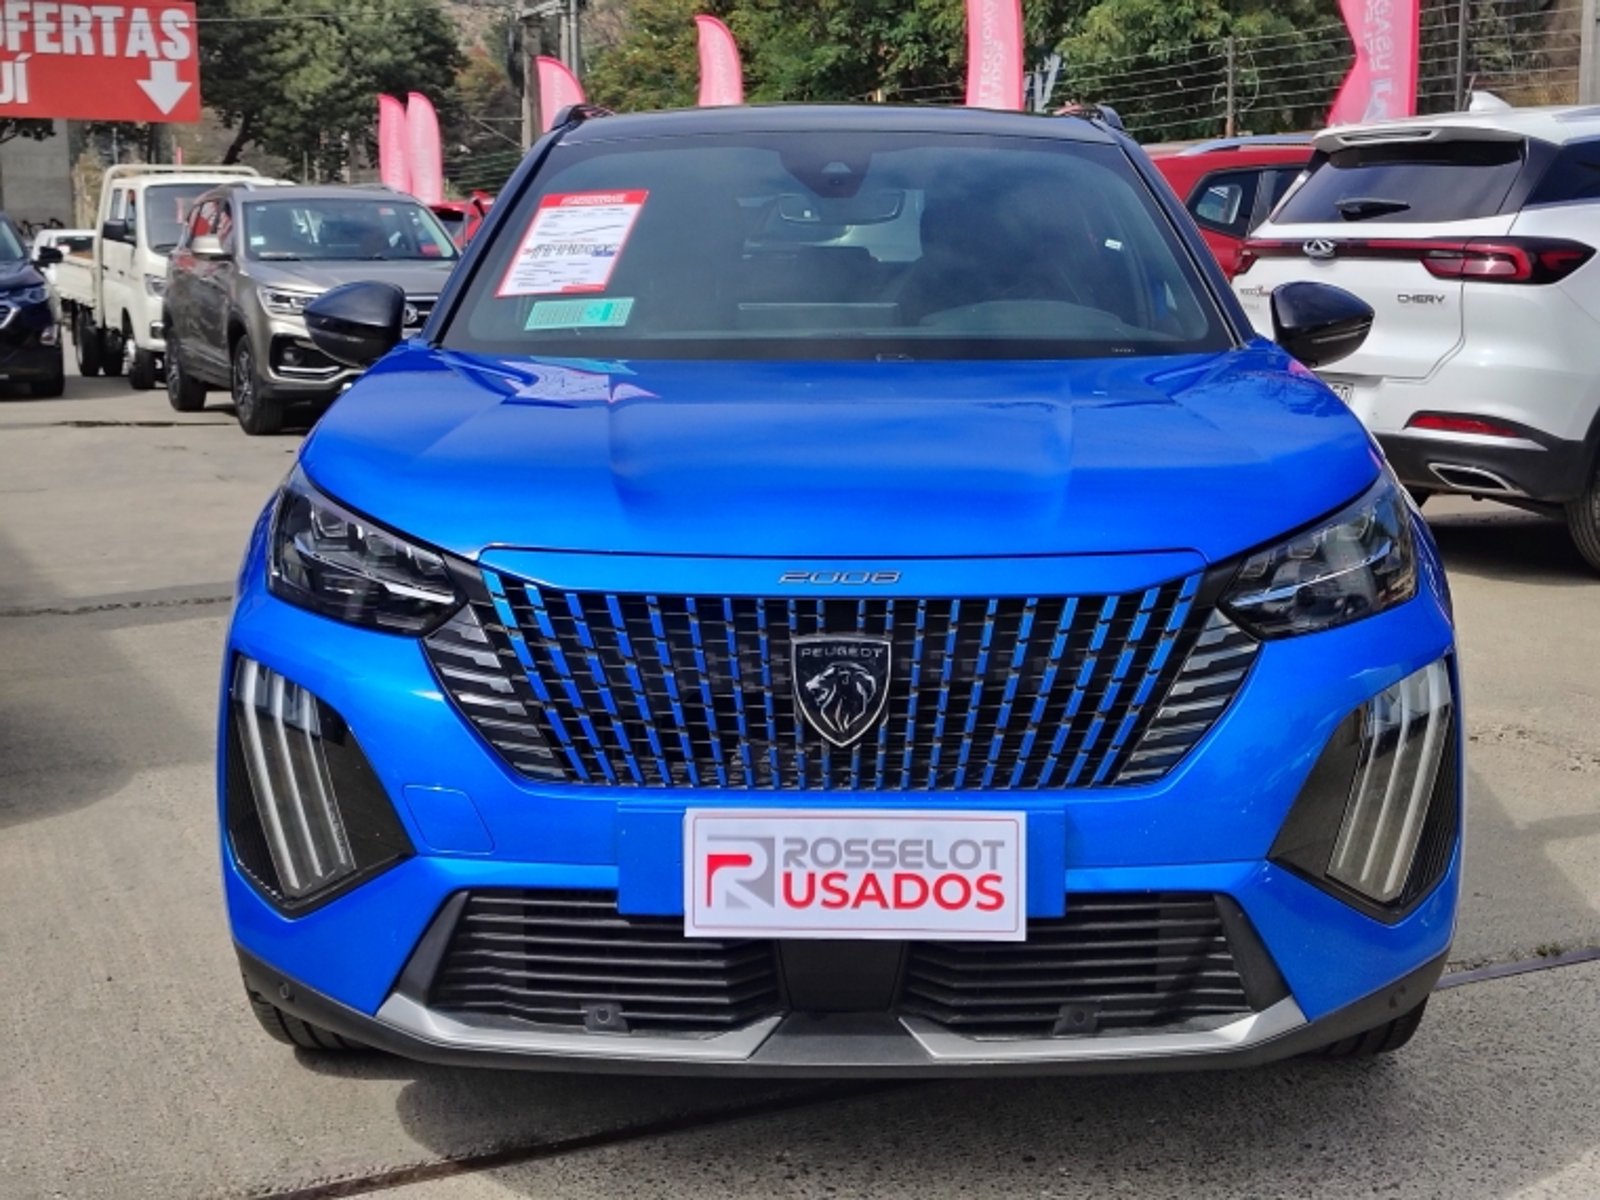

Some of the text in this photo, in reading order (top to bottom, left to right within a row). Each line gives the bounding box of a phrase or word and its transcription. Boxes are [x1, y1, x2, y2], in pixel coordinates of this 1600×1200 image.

[0, 0, 190, 60] FERTAS
[1397, 294, 1446, 304] CHERY
[778, 570, 901, 584] 2008
[801, 645, 884, 658] PEUGEOT
[782, 836, 1006, 871] ROSSELOT
[782, 871, 1006, 912] USADOS
